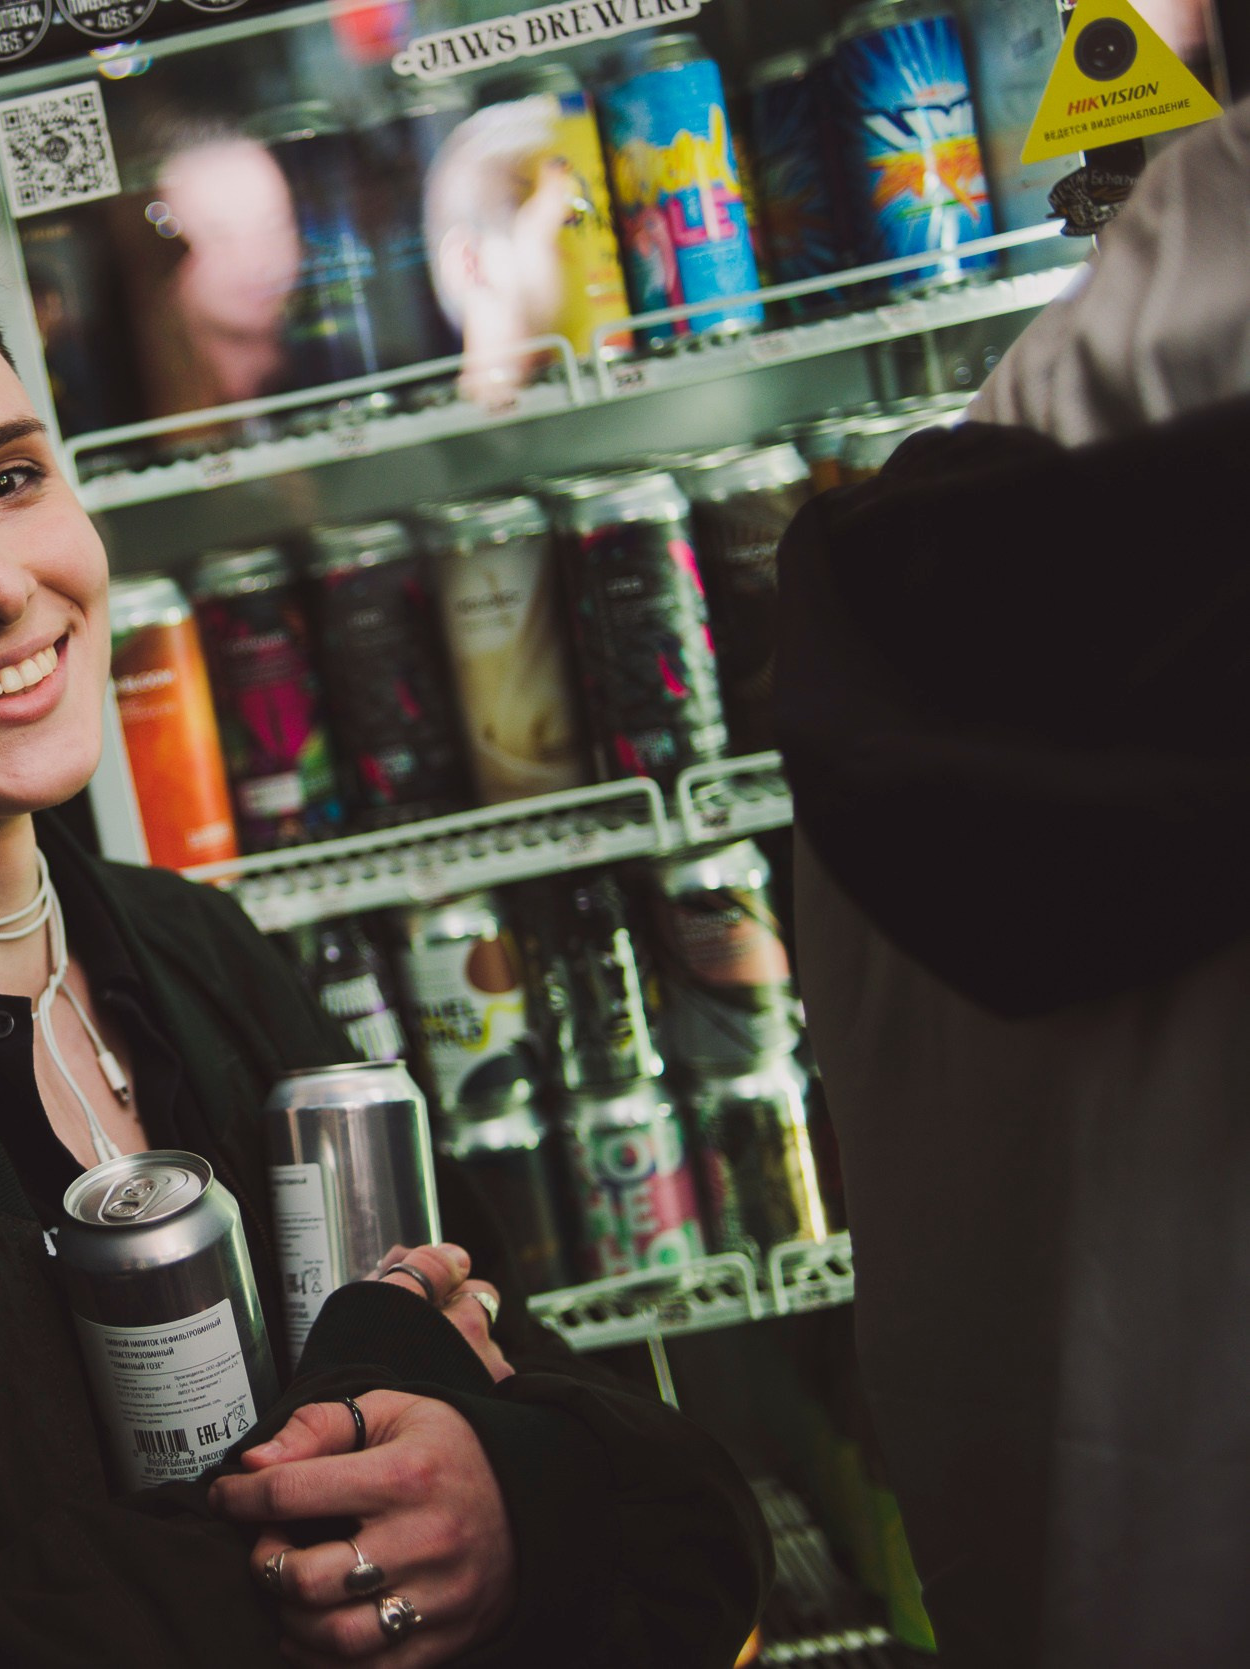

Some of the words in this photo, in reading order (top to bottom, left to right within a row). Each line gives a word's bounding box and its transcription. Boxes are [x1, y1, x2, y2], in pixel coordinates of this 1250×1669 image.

[418, 23, 517, 72] JAWS
[1066, 81, 1159, 116] HIKVISION
[1044, 122, 1088, 142] ВЕДЕТСЯ
[1091, 98, 1191, 131] ВИДЕОНАБЛЮДЕНИЕ
[130, 1338, 160, 1348] НАПИТОК
[160, 1316, 222, 1345] НЕФИЛЬТРОВАННЫЙ
[107, 1346, 175, 1359] НЕПАСТЕРИЗОВАННЫЙ
[169, 1465, 199, 1476] ВАШЕМУ
